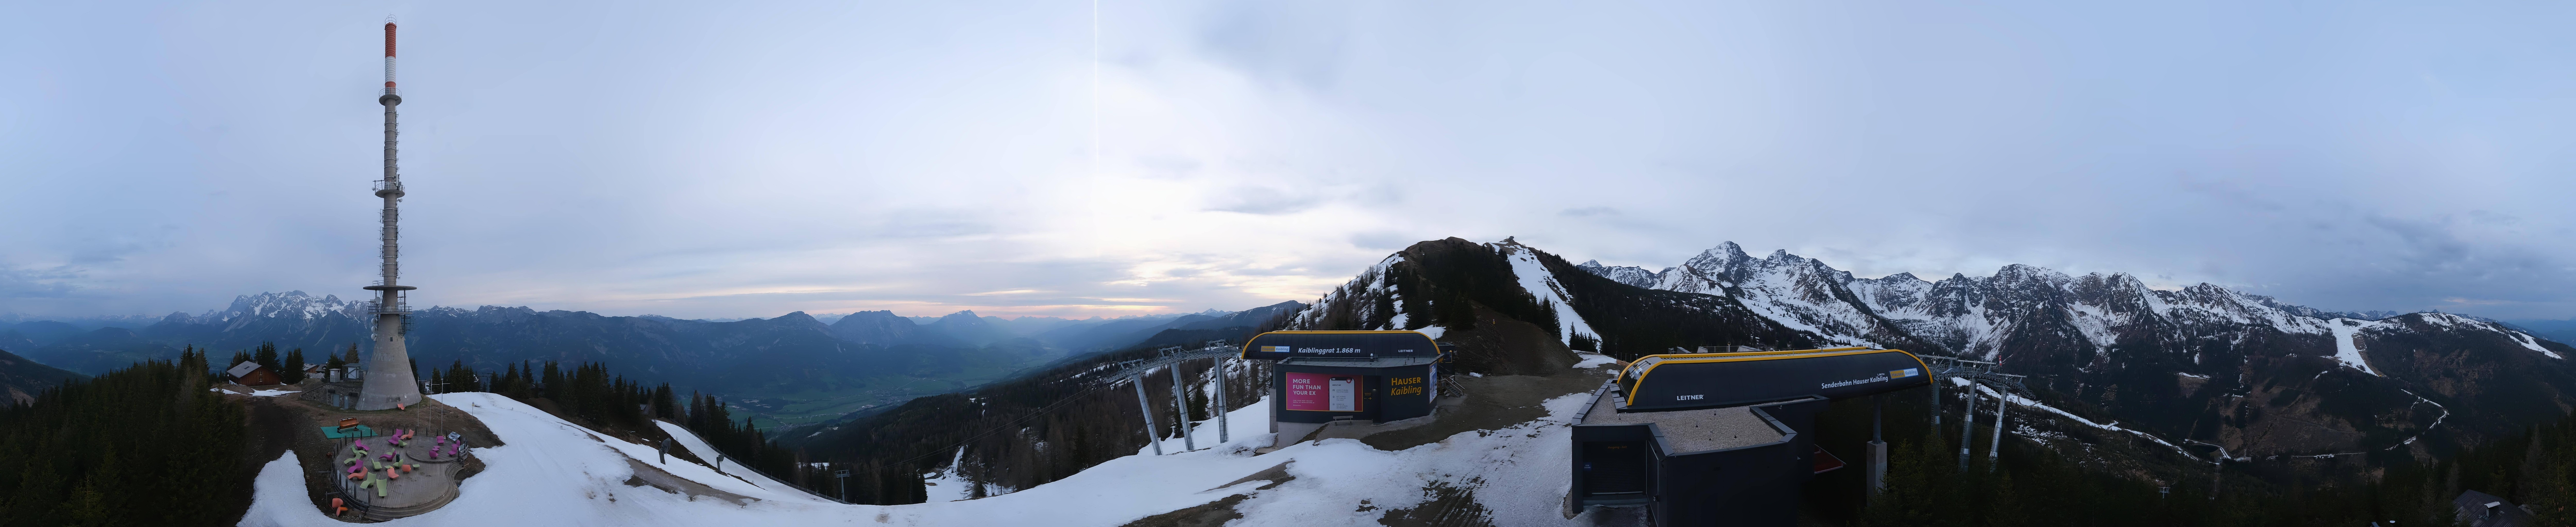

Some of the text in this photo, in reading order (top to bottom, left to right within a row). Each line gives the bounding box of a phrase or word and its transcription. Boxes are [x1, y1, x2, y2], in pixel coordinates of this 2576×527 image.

[1391, 377, 1421, 386] HAUSER
[1821, 380, 1852, 389] Senderbahn
[1391, 386, 1422, 396] Kaibling
